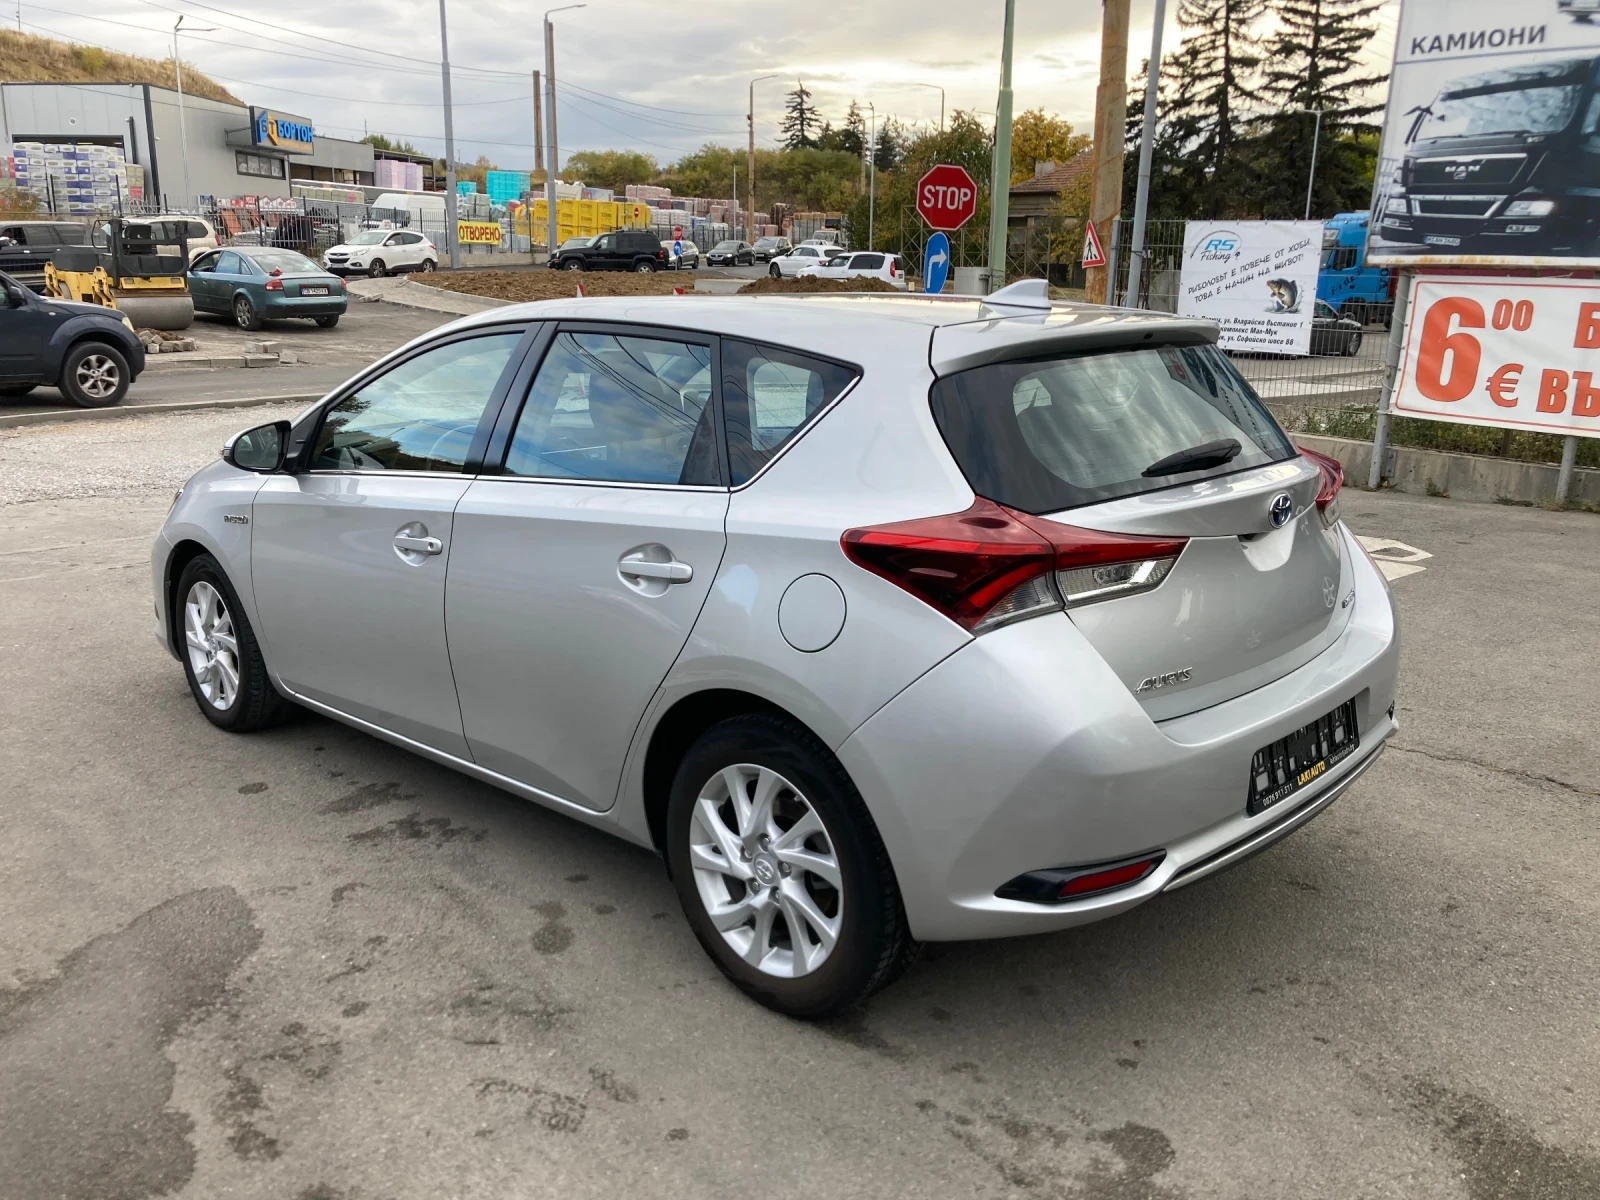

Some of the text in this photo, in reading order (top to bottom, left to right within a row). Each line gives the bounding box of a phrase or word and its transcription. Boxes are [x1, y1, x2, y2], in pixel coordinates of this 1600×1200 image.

[1411, 24, 1547, 55] КАМИОНИ
[277, 120, 313, 143] БОРТОН
[1445, 165, 1480, 173] MAN
[923, 185, 972, 210] STOP
[458, 225, 501, 241] ОТВОРЕНО
[1201, 250, 1231, 263] Fishing
[1205, 239, 1238, 251] RS
[1231, 268, 1237, 277] Е
[1240, 253, 1271, 273] ПОВЕЧЕ
[1274, 248, 1284, 259] ОТ
[1194, 290, 1213, 303] ТОВА
[1216, 286, 1222, 295] Е
[1224, 273, 1254, 291] НАЧИН
[1258, 268, 1270, 278] НА
[1250, 327, 1278, 336] Мал-Мук
[1135, 667, 1194, 693] AURIS
